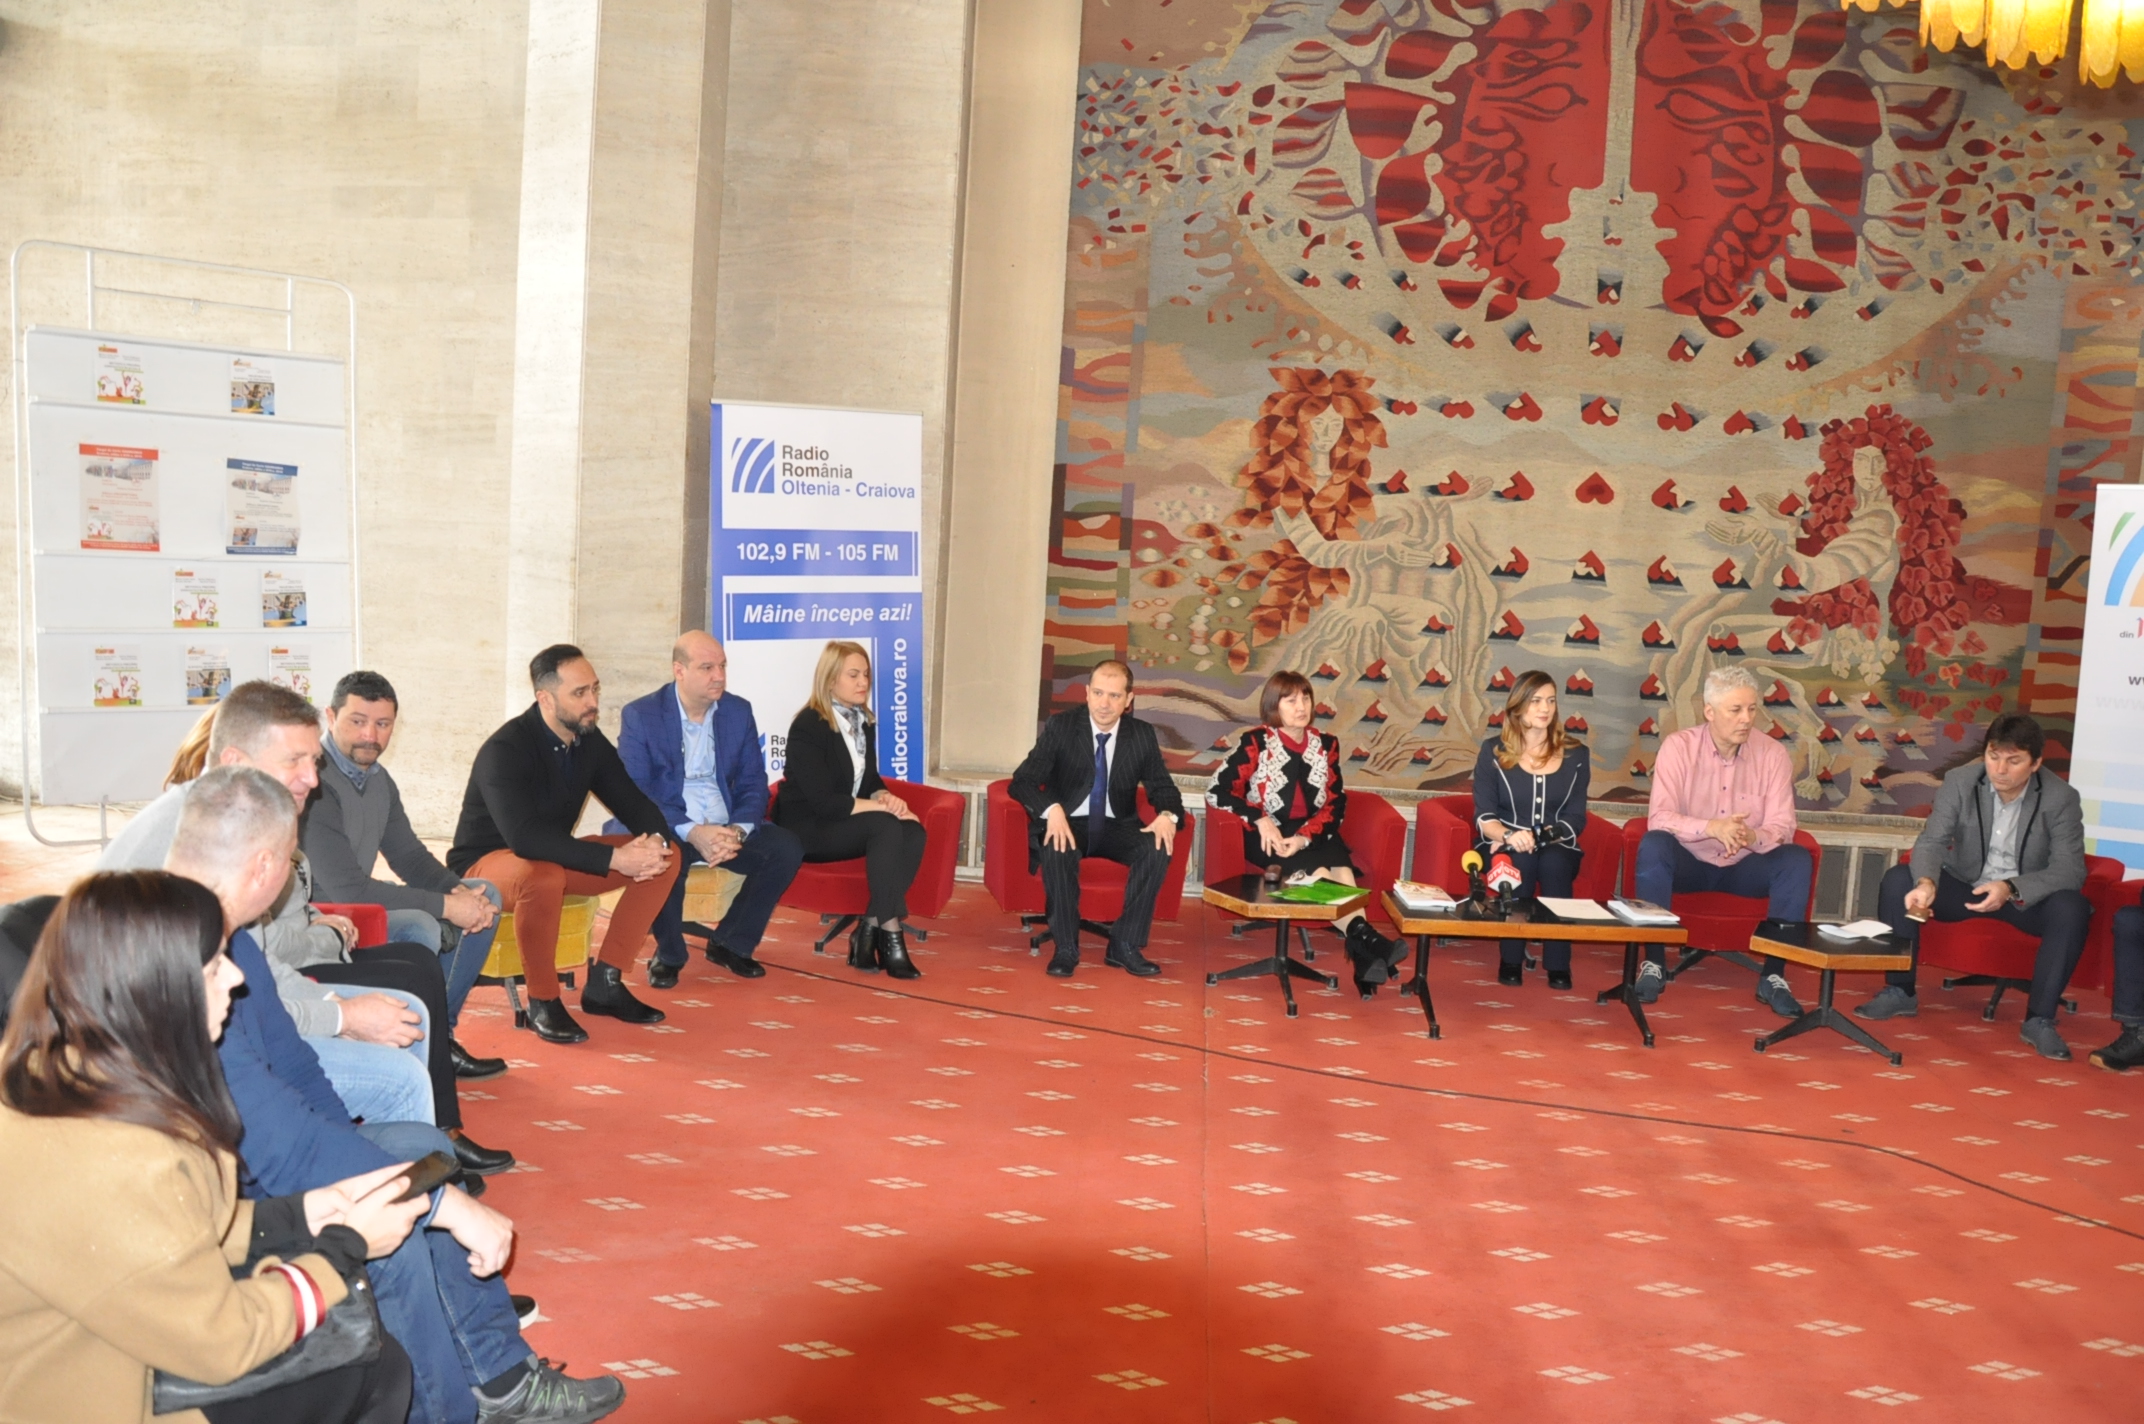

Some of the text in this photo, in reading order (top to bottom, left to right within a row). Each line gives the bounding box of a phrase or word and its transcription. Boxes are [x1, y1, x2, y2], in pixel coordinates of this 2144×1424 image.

[782, 445, 829, 461] Radio
[782, 462, 853, 479] România
[781, 479, 840, 496] Oltenia
[856, 482, 915, 499] Craiova
[736, 542, 787, 563] 102,9
[792, 543, 820, 560] FM
[837, 544, 867, 561] 105
[872, 544, 899, 562] FM
[743, 603, 912, 626] Mâine începe azi!
